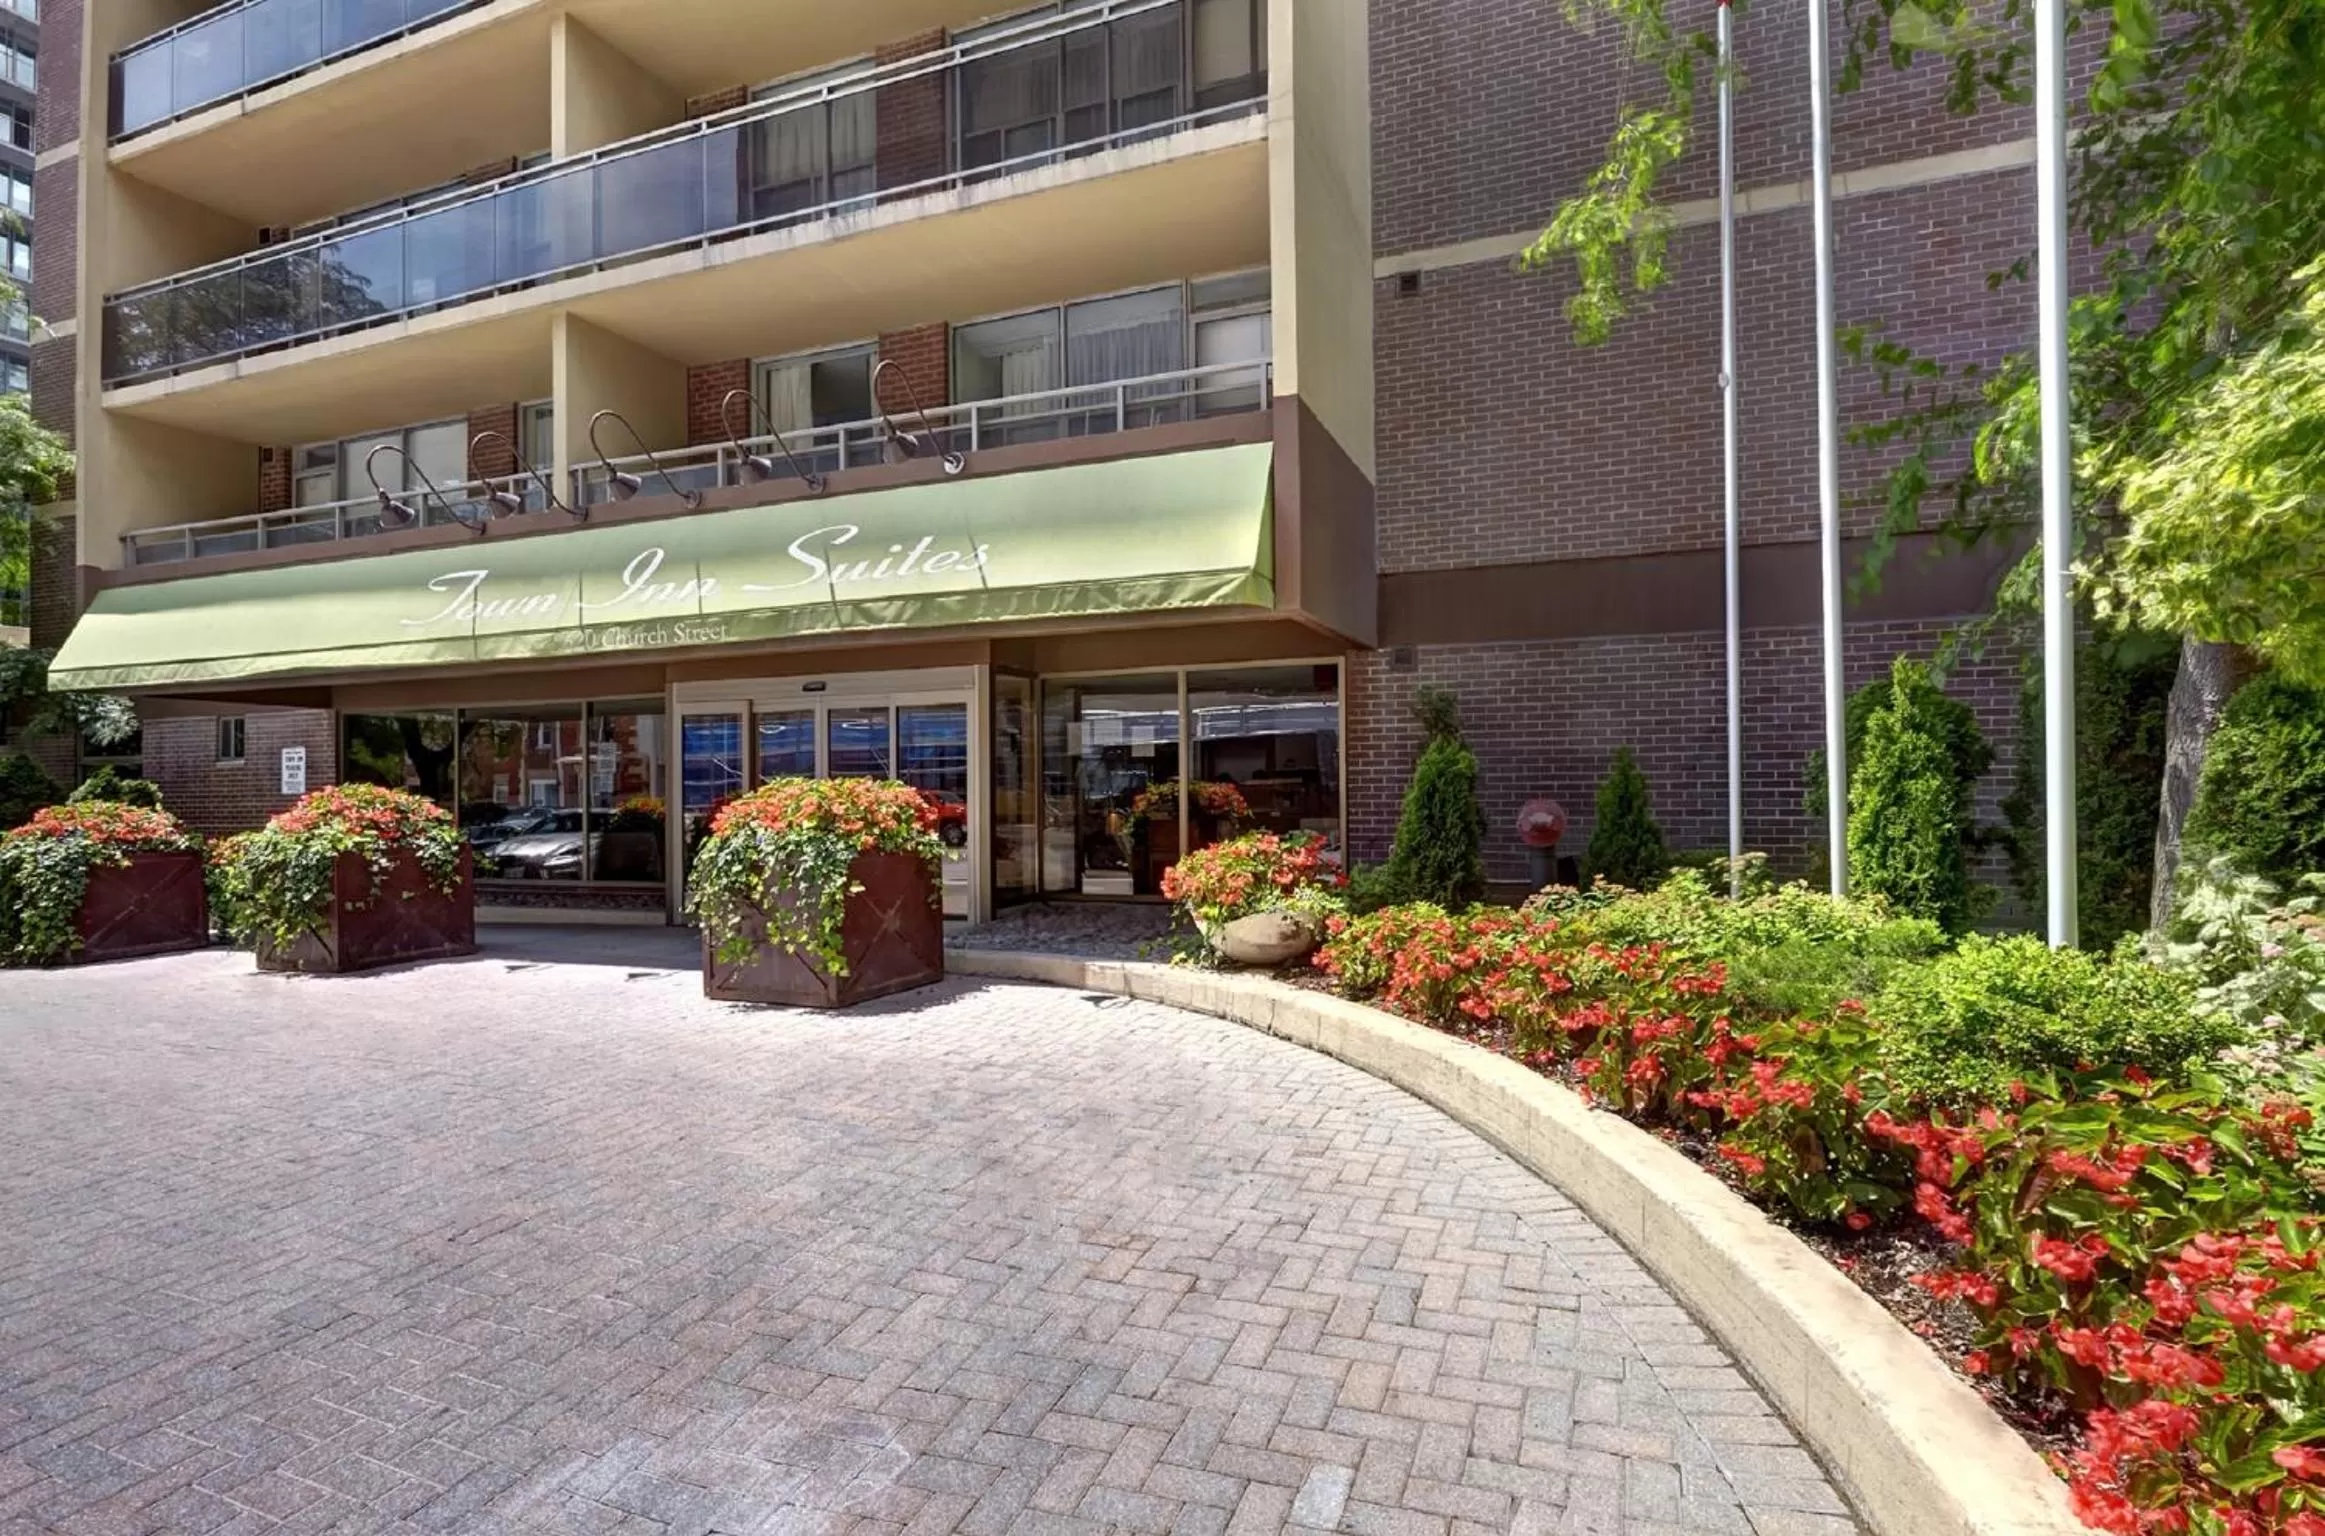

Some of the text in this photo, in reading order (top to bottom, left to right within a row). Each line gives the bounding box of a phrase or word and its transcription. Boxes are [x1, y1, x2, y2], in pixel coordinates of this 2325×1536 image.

[399, 524, 990, 625] Town Inn Suites
[601, 624, 668, 648] Church
[673, 621, 728, 643] Street
